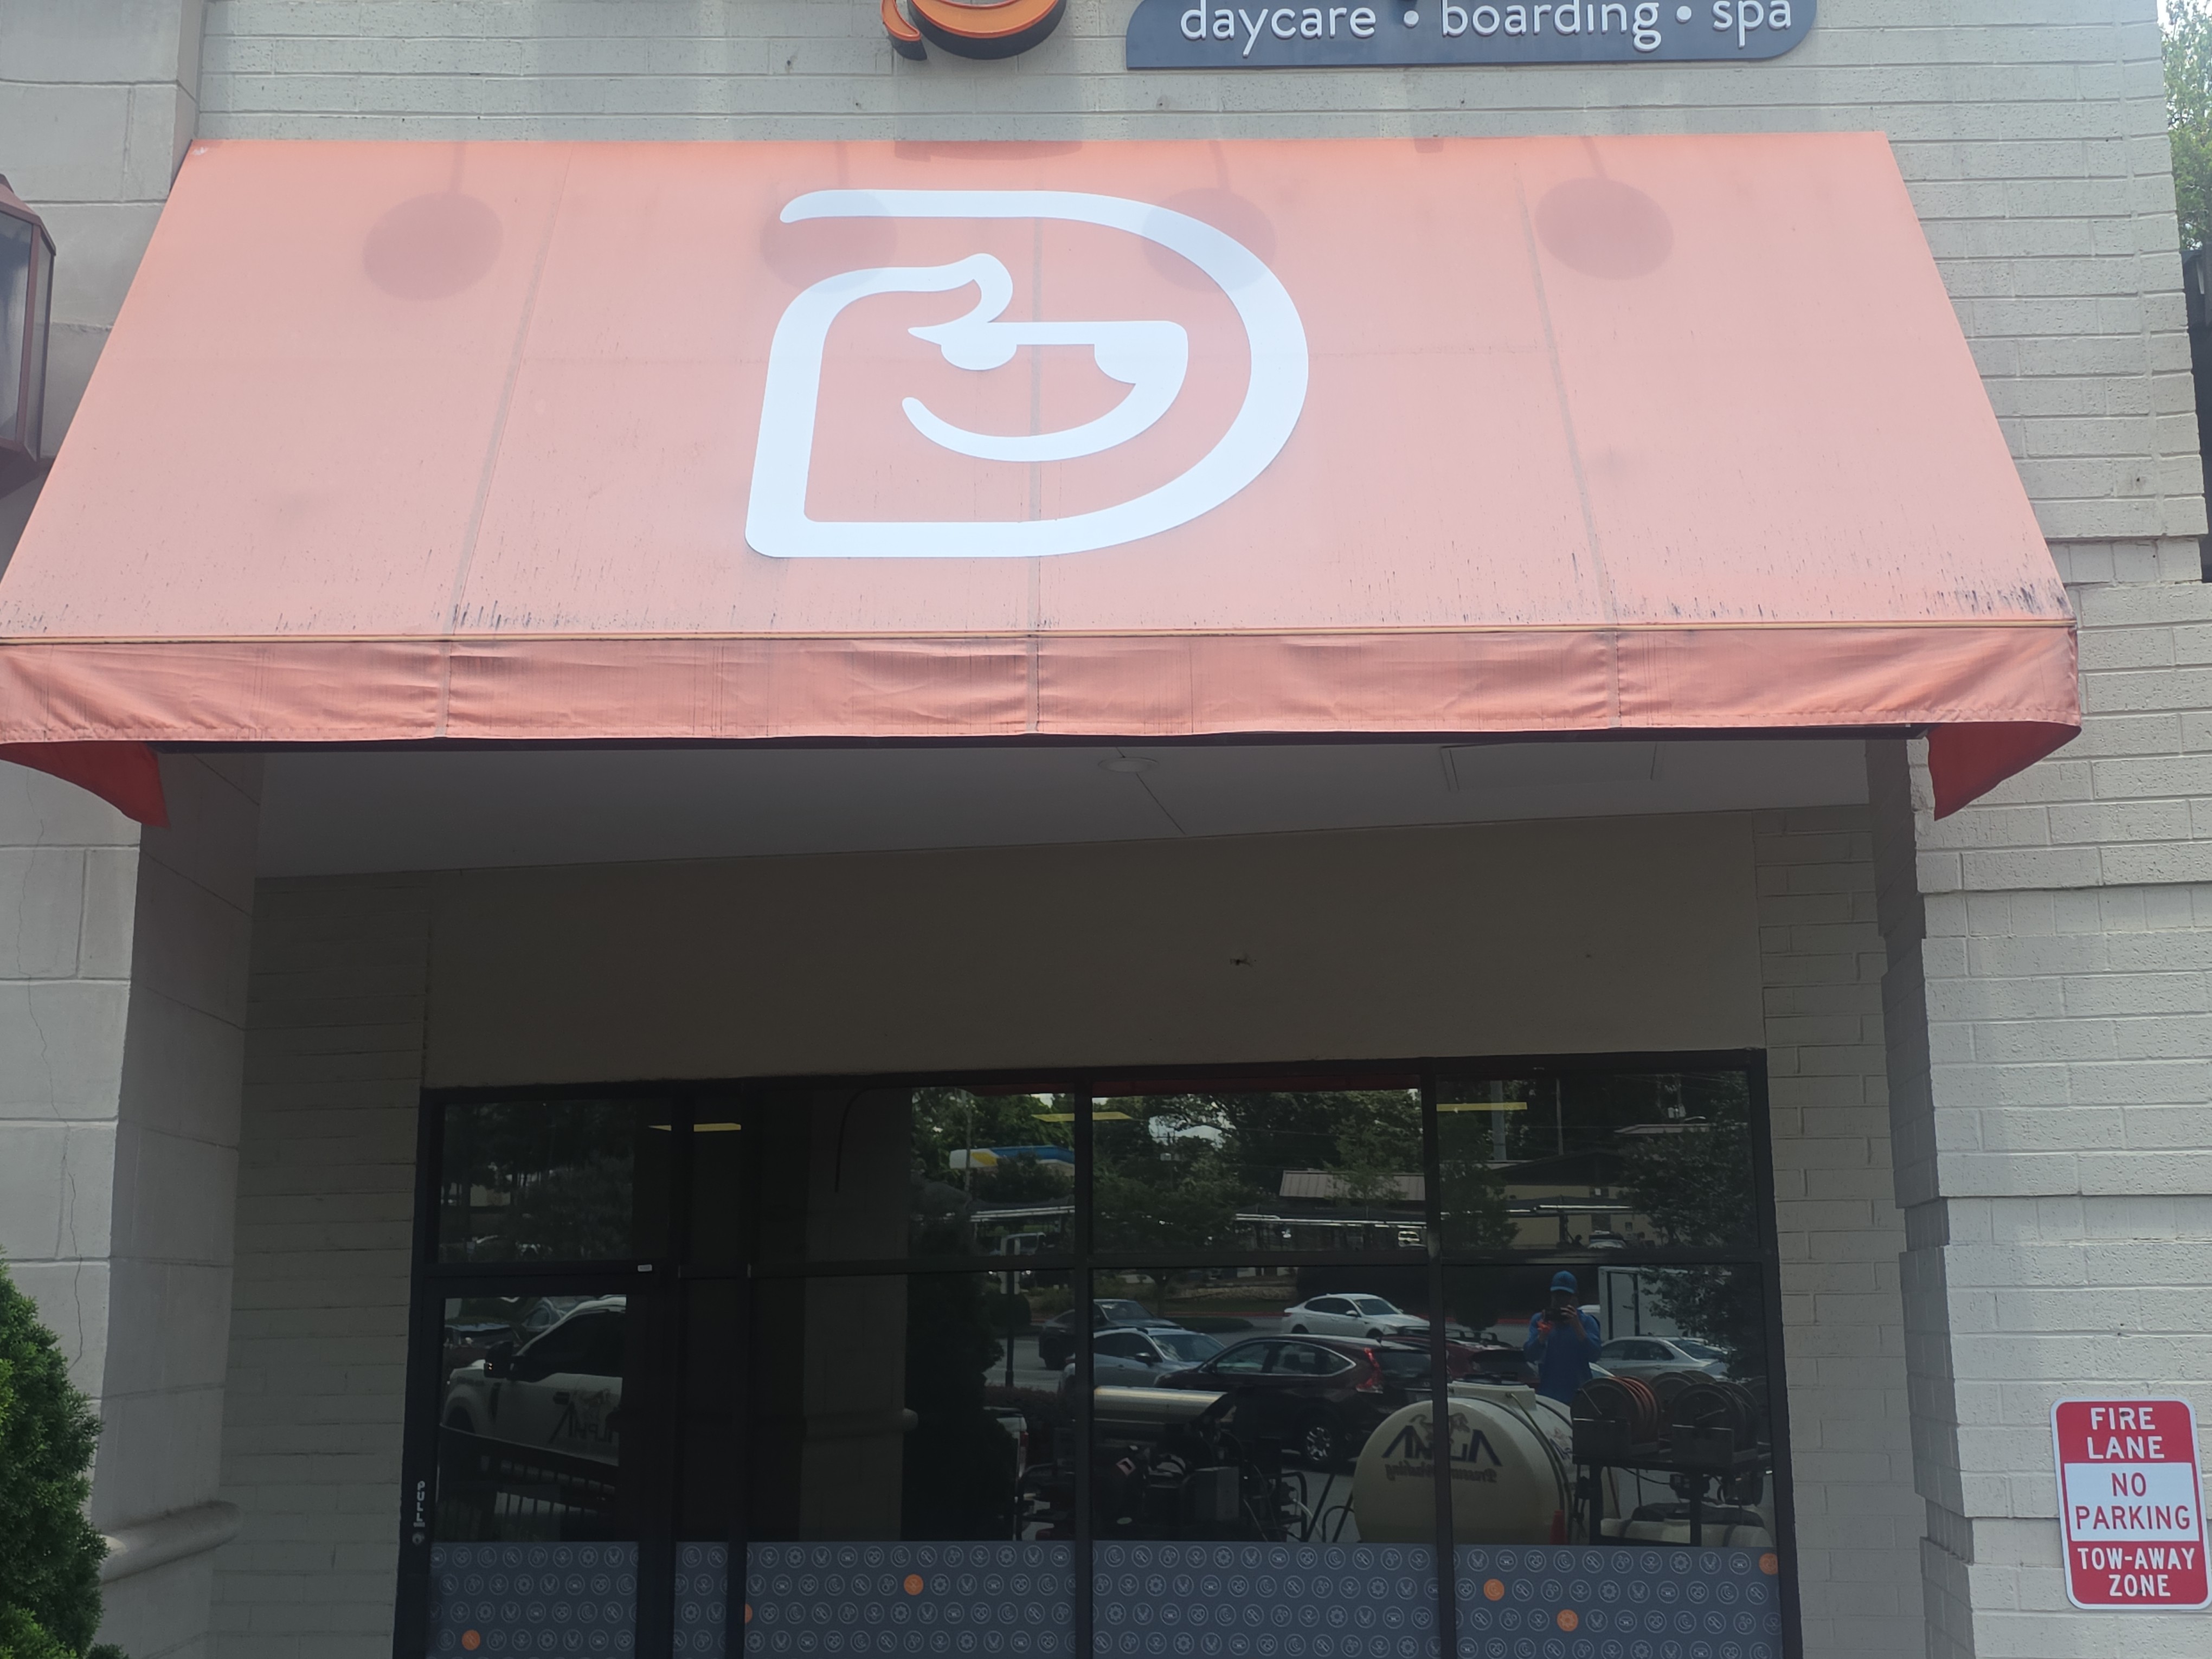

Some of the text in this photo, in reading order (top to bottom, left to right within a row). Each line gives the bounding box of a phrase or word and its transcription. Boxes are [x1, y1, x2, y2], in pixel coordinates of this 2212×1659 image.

[1179, 0, 1792, 56] daycare boarding spa
[2090, 1407, 2156, 1430] FIRE
[2087, 1436, 2165, 1459] LANE
[2111, 1472, 2147, 1497] NO
[416, 1481, 426, 1522] PULL
[2075, 1505, 2190, 1530] PARKING
[2077, 1548, 2195, 1570] TOW-AWAY
[2108, 1574, 2171, 1597] ZONE
